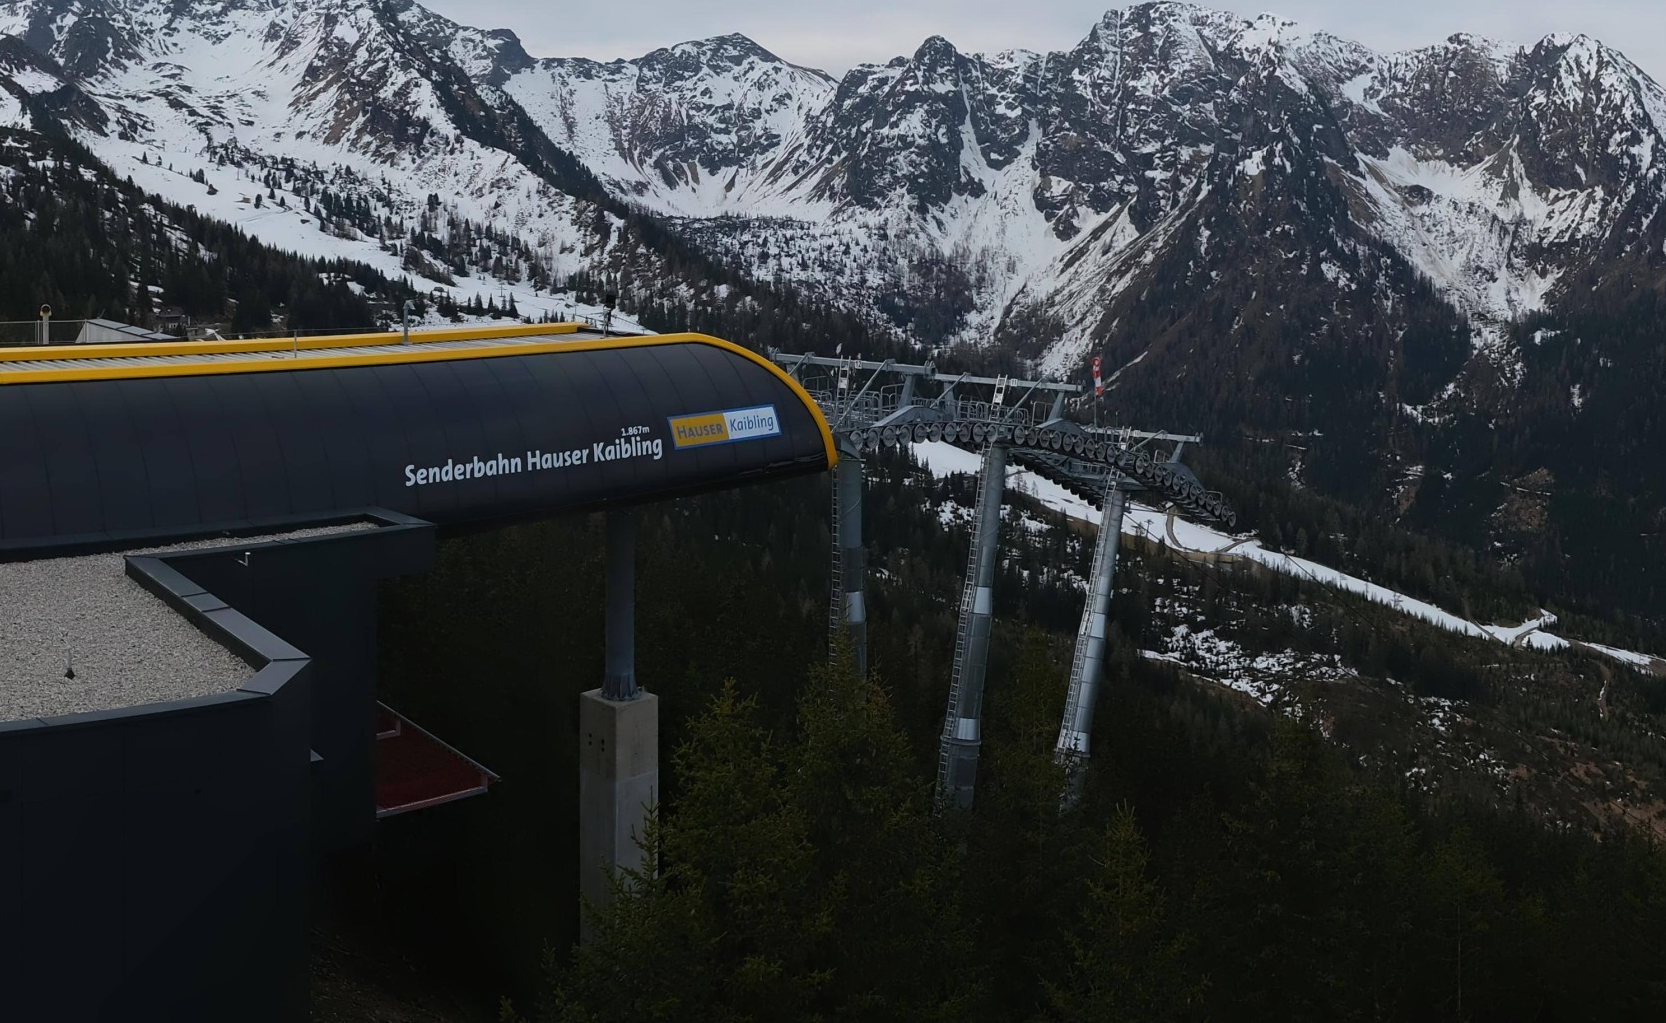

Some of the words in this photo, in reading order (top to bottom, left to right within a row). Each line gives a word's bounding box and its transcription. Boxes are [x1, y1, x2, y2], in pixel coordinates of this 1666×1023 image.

[621, 425, 650, 437] 1.867m
[676, 421, 724, 441] HAUSER
[729, 413, 775, 433] Kaibling
[404, 452, 522, 488] Senderbahn
[526, 446, 590, 473] Hauser
[593, 436, 663, 463] Kaibling
